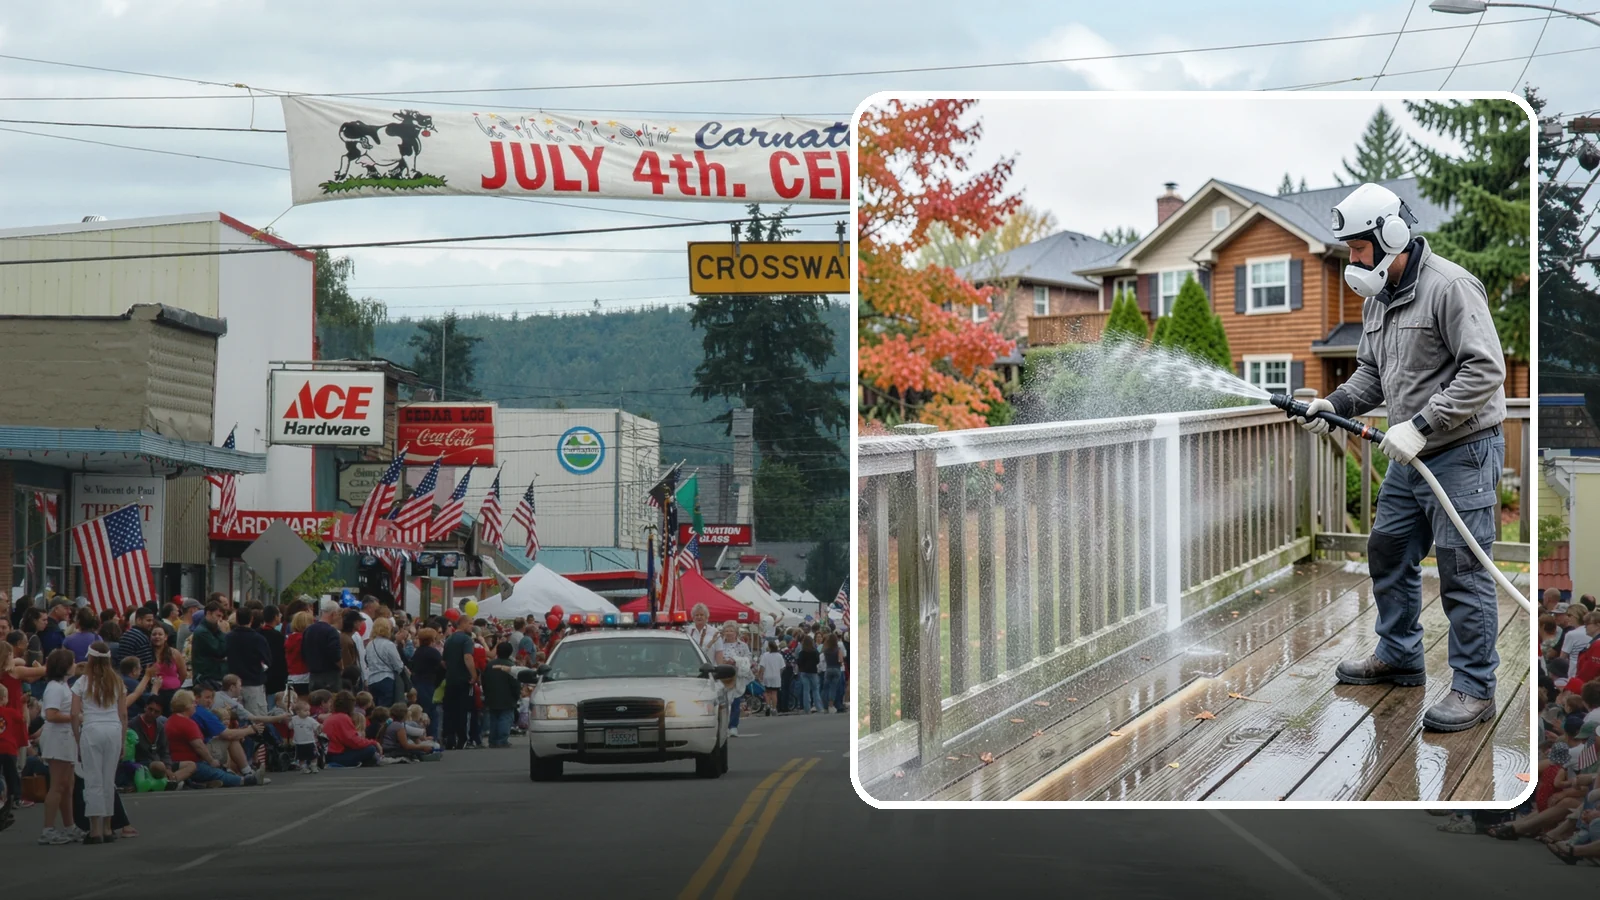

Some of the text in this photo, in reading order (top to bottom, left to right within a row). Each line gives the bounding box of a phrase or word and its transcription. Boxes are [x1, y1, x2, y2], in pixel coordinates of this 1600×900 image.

[481, 141, 605, 192] JULY
[632, 150, 746, 197] 4th.
[697, 254, 850, 280] CROSSWA
[283, 380, 373, 420] ACE
[406, 409, 485, 422] CEDAR LOG
[283, 421, 371, 437] Hardware
[416, 428, 477, 447] Coca-Cola
[83, 484, 155, 495] St. Vincent de Paul
[688, 526, 741, 535] CRNATION
[699, 535, 730, 543] GLASS
